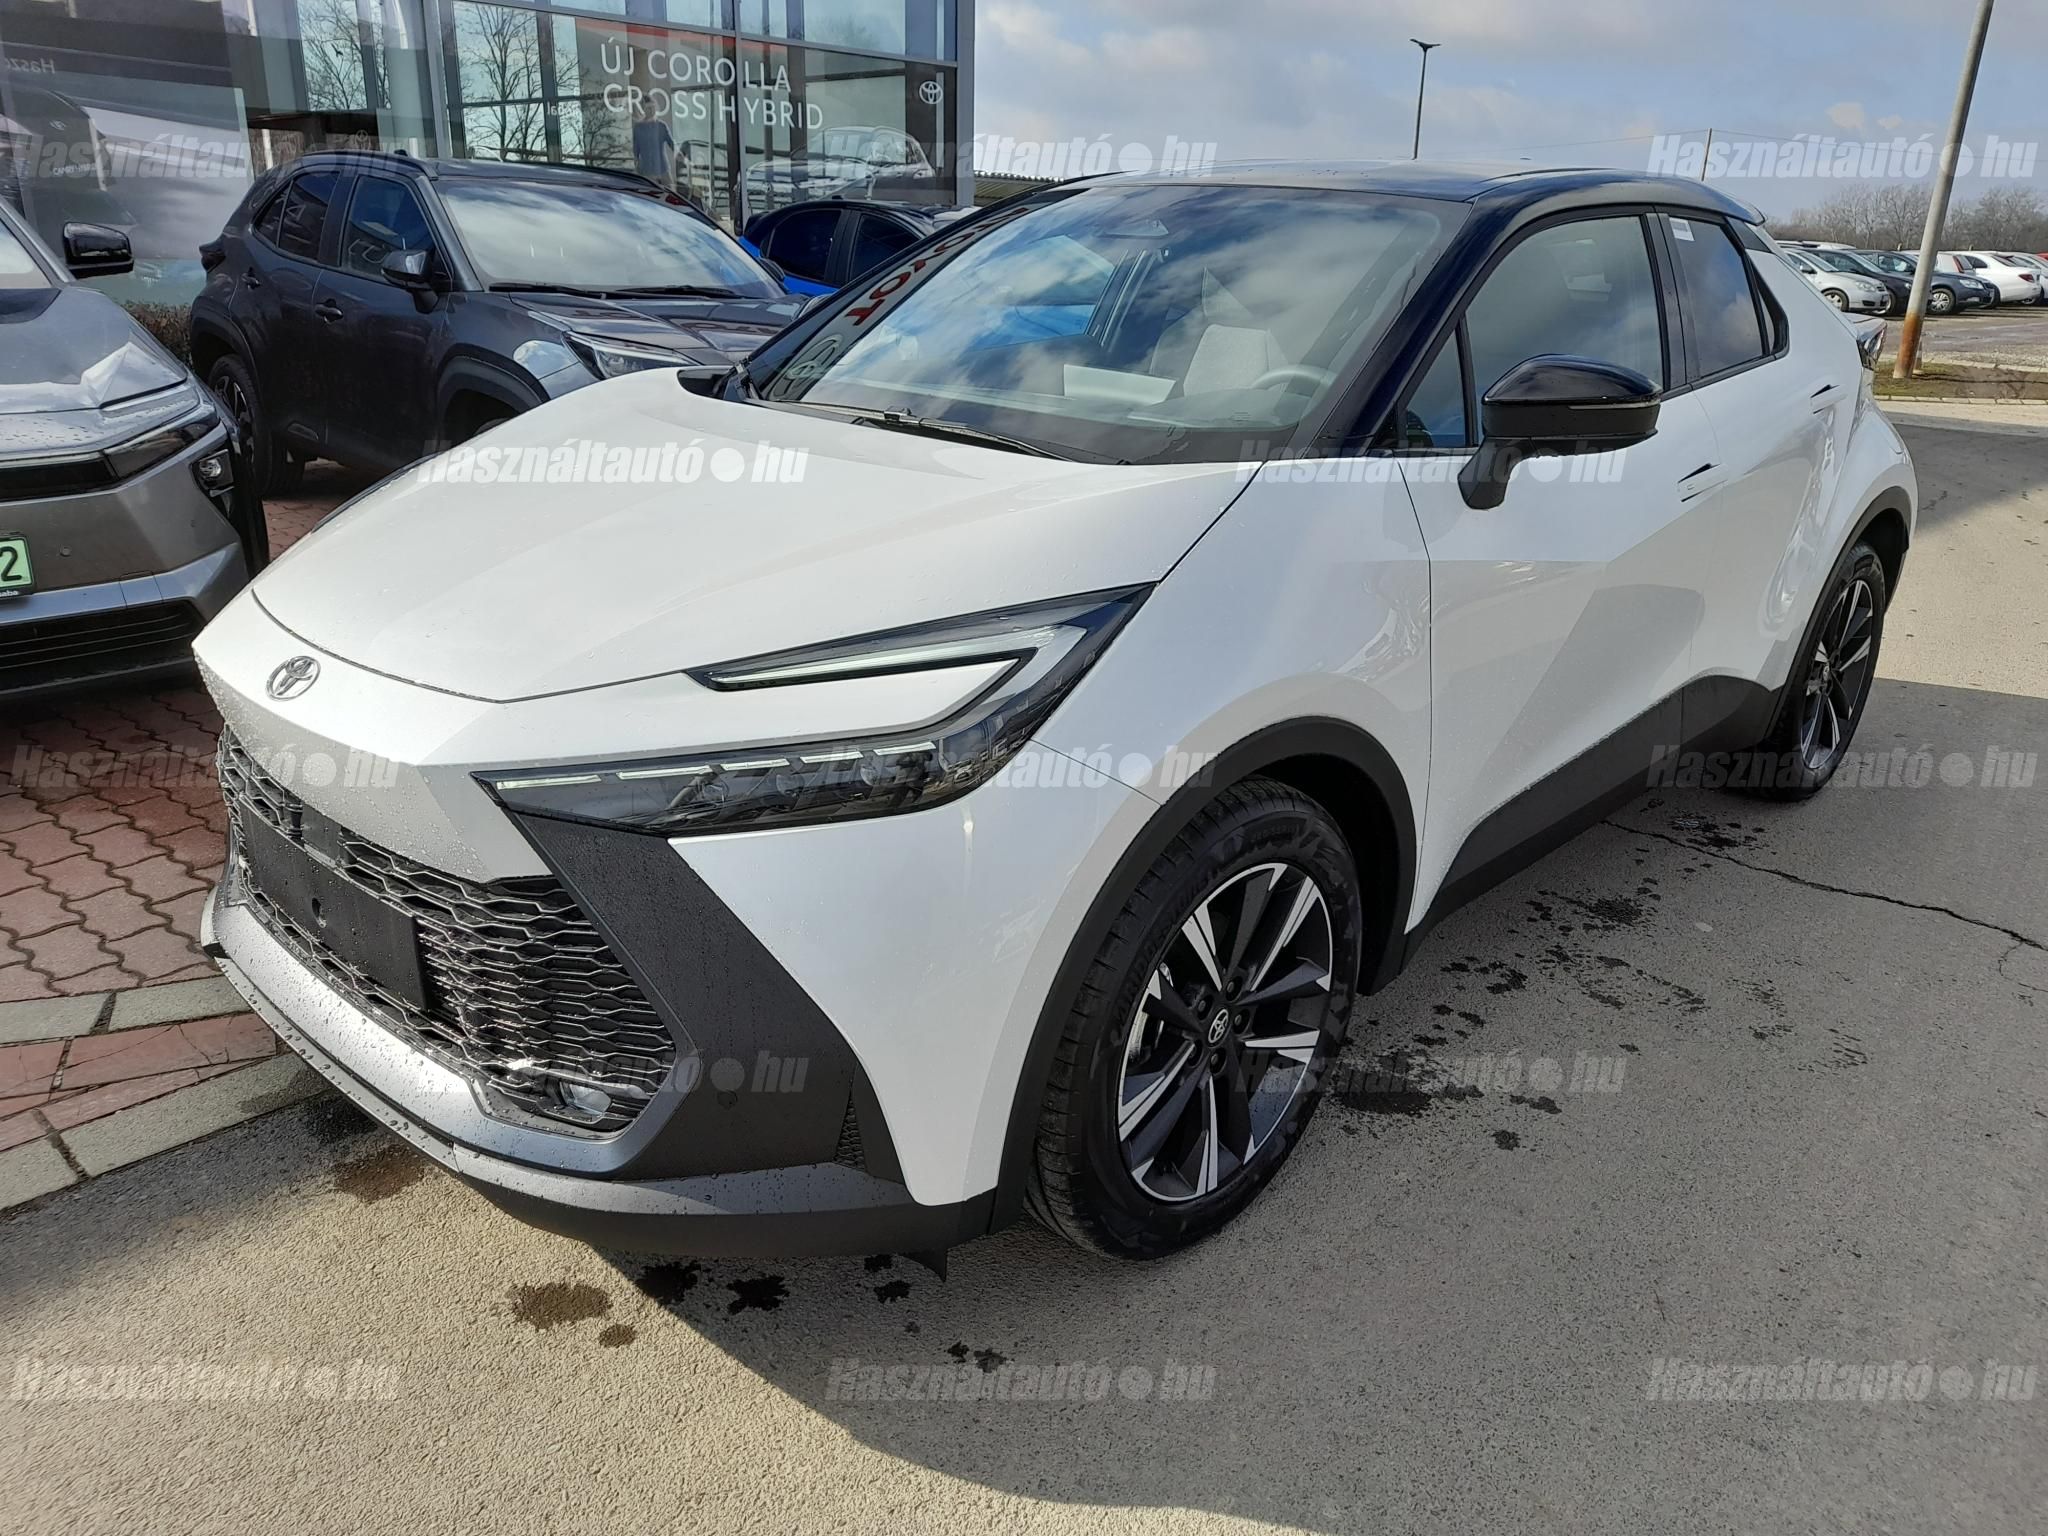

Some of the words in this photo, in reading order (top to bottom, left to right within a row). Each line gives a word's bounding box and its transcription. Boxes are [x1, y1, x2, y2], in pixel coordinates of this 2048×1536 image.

[600, 37, 634, 75] ÚJ
[648, 49, 792, 93] COROLLA
[603, 83, 707, 120] CROSS
[718, 94, 824, 129] HYBRID
